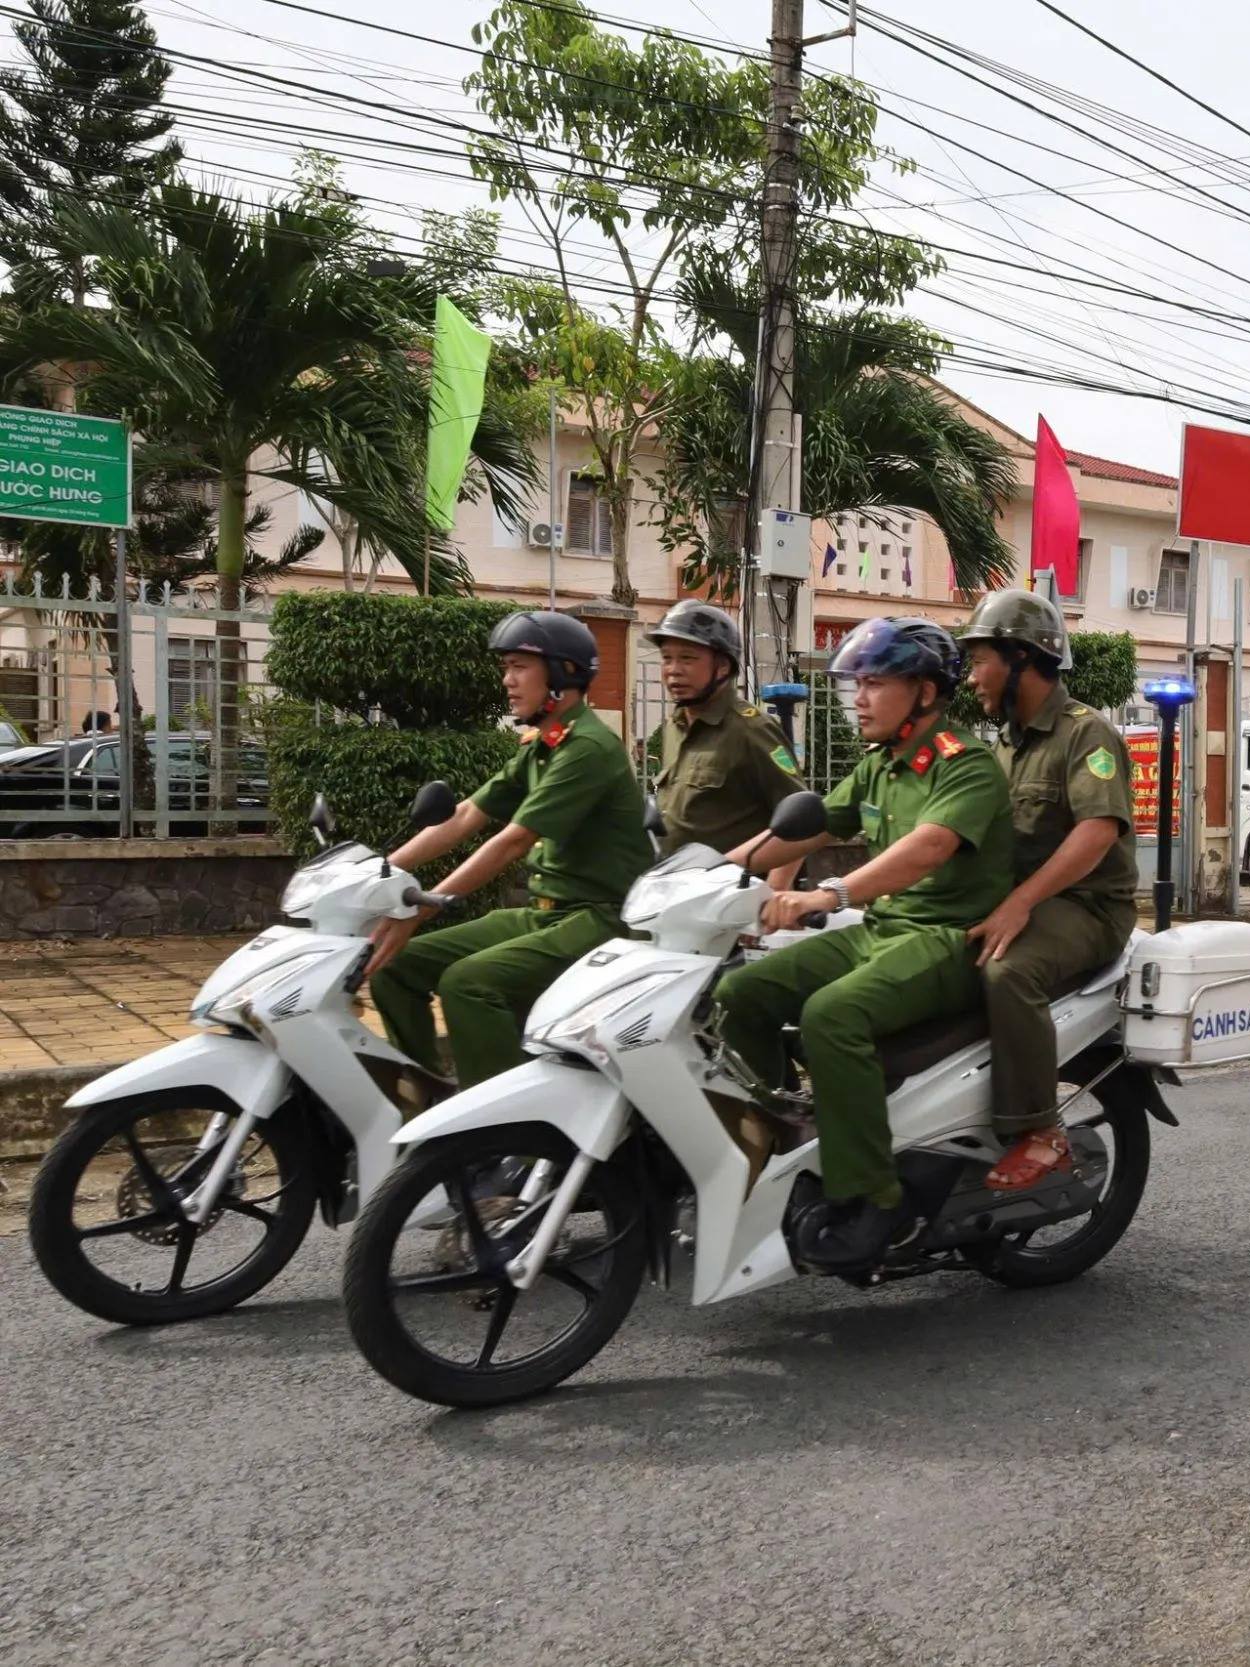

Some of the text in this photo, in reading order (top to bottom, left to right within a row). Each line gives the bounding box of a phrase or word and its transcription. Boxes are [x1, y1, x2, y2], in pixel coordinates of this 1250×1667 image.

[28, 416, 53, 425] GIAO
[0, 459, 96, 482] GIAO DỊCH
[49, 486, 103, 504] HƯNG
[1192, 1010, 1236, 1040] CẢNH
